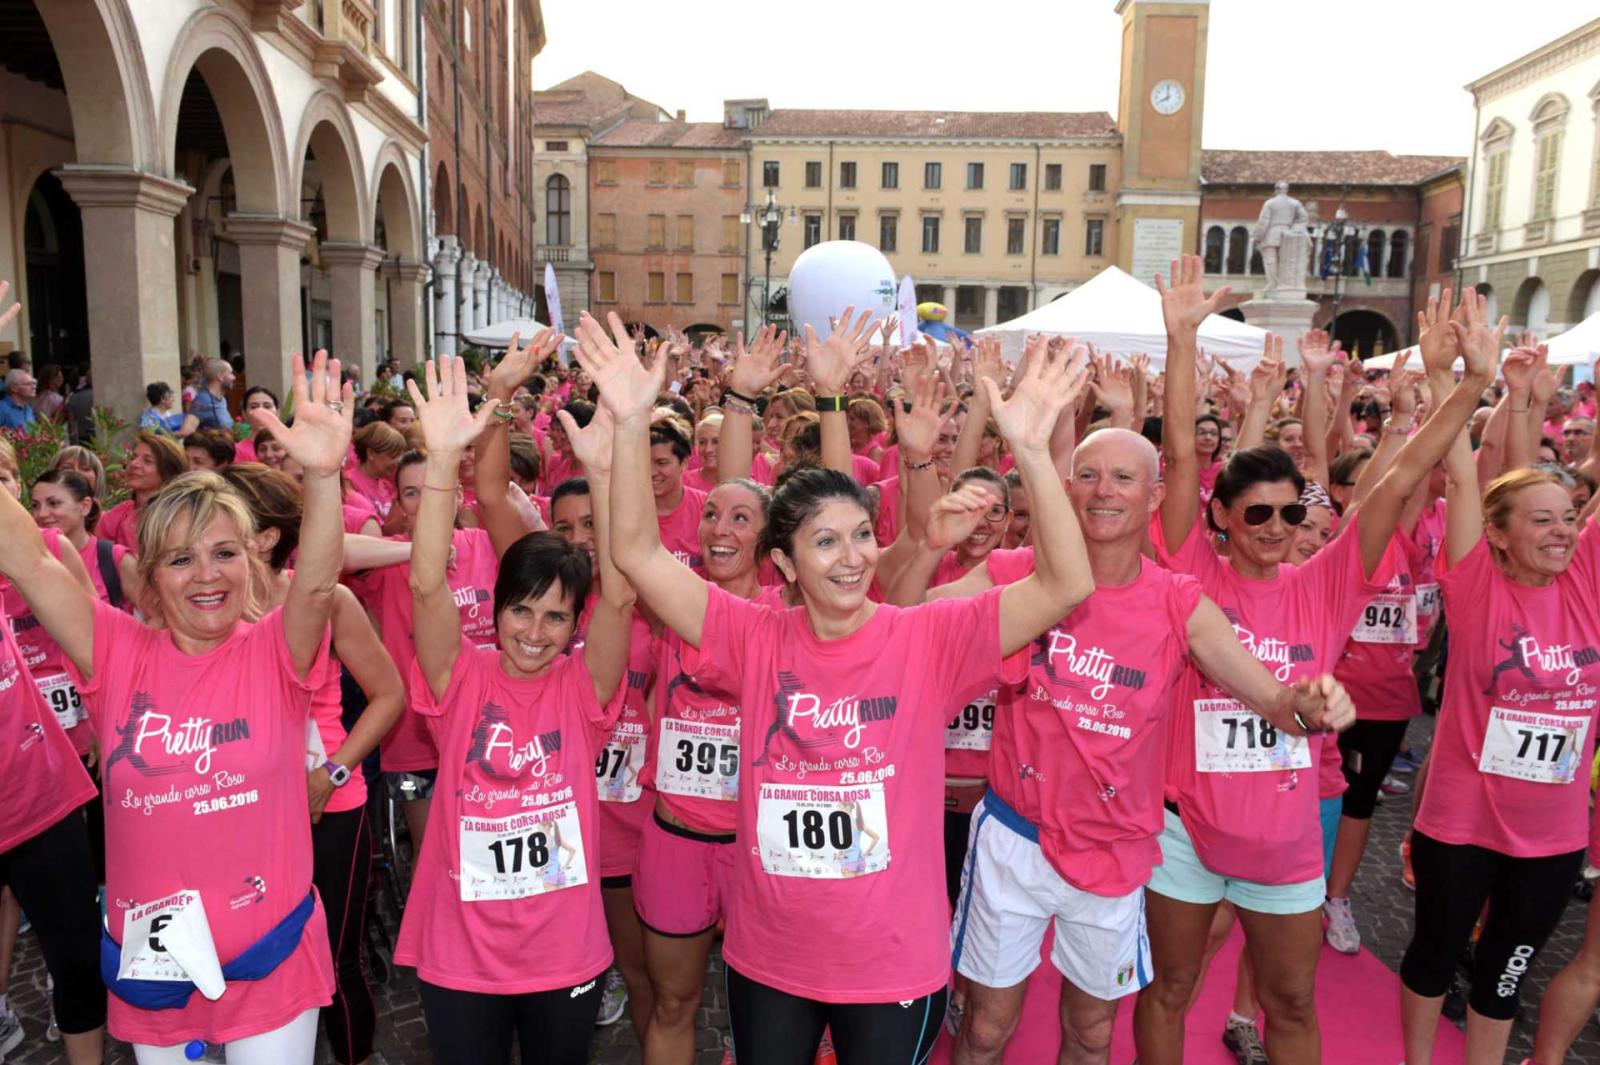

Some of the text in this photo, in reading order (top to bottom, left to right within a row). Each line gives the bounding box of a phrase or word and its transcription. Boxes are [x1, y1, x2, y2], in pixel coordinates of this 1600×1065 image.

[1365, 605, 1403, 628] 942
[1048, 629, 1146, 701] Pretty RUN
[1518, 636, 1582, 686] Pretty
[43, 686, 82, 713] 95
[674, 722, 703, 735] GRANDE
[786, 692, 896, 748] Pretty RUN
[1077, 716, 1132, 739] 25.06.2016
[1222, 718, 1277, 748] 718
[135, 711, 250, 774] Pretty RUN
[1517, 730, 1567, 762] 717
[595, 747, 625, 778] 97
[676, 739, 738, 777] 395
[796, 757, 833, 779] grande
[143, 785, 182, 816] grande
[212, 770, 246, 791] Rosa
[193, 790, 259, 816] 25.06.2016
[484, 785, 521, 810] grande
[763, 788, 871, 802] LA GRANDE CORSA ROSA
[464, 821, 474, 832] LA
[474, 821, 509, 833] GRANDE
[510, 814, 541, 830] CORSA
[541, 808, 567, 824] ROSA
[783, 810, 853, 850] 180
[488, 832, 550, 874] 178
[131, 910, 143, 922] LA
[145, 895, 184, 916] GRANDE
